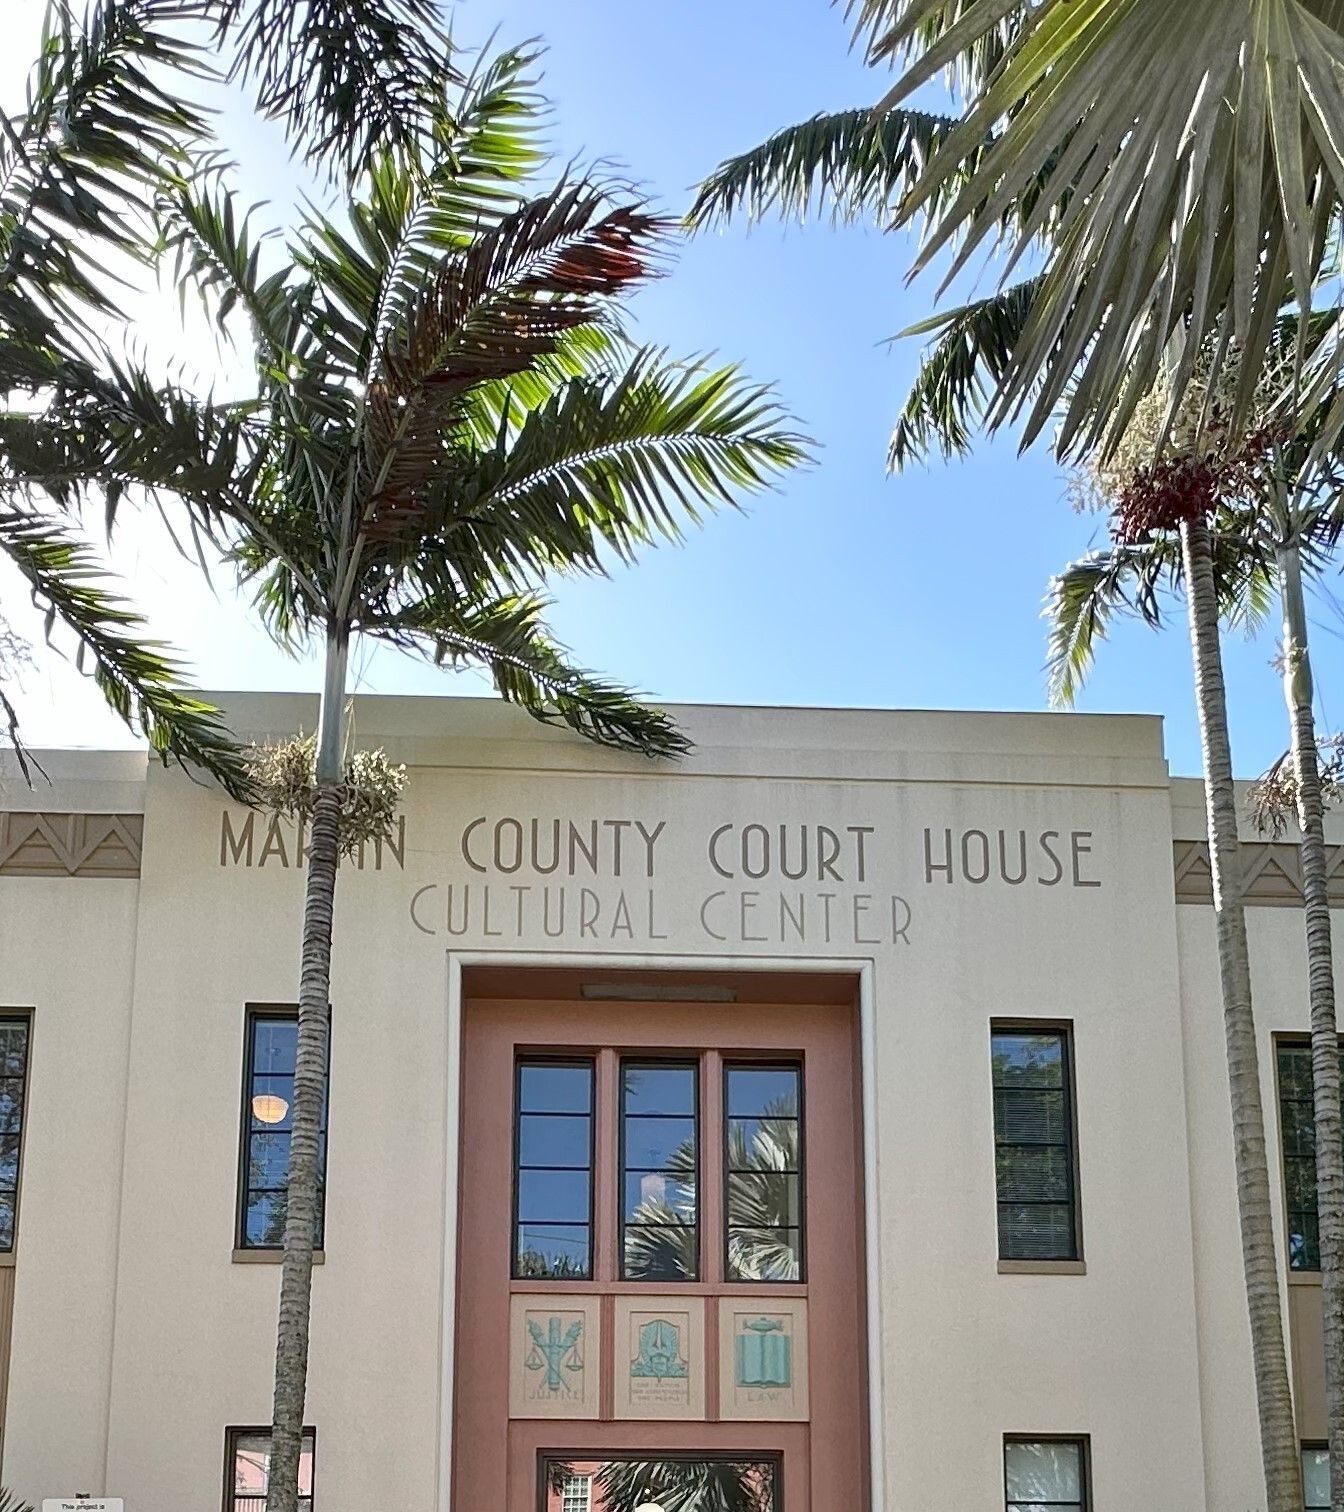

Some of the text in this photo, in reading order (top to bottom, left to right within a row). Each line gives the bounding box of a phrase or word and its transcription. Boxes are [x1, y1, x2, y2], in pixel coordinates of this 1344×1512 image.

[461, 817, 667, 877] COUNTY
[709, 824, 874, 882] COURT
[924, 828, 1101, 887] HOUSE
[410, 884, 912, 945] CULTURAL CENTER
[747, 1391, 780, 1401] LAW
